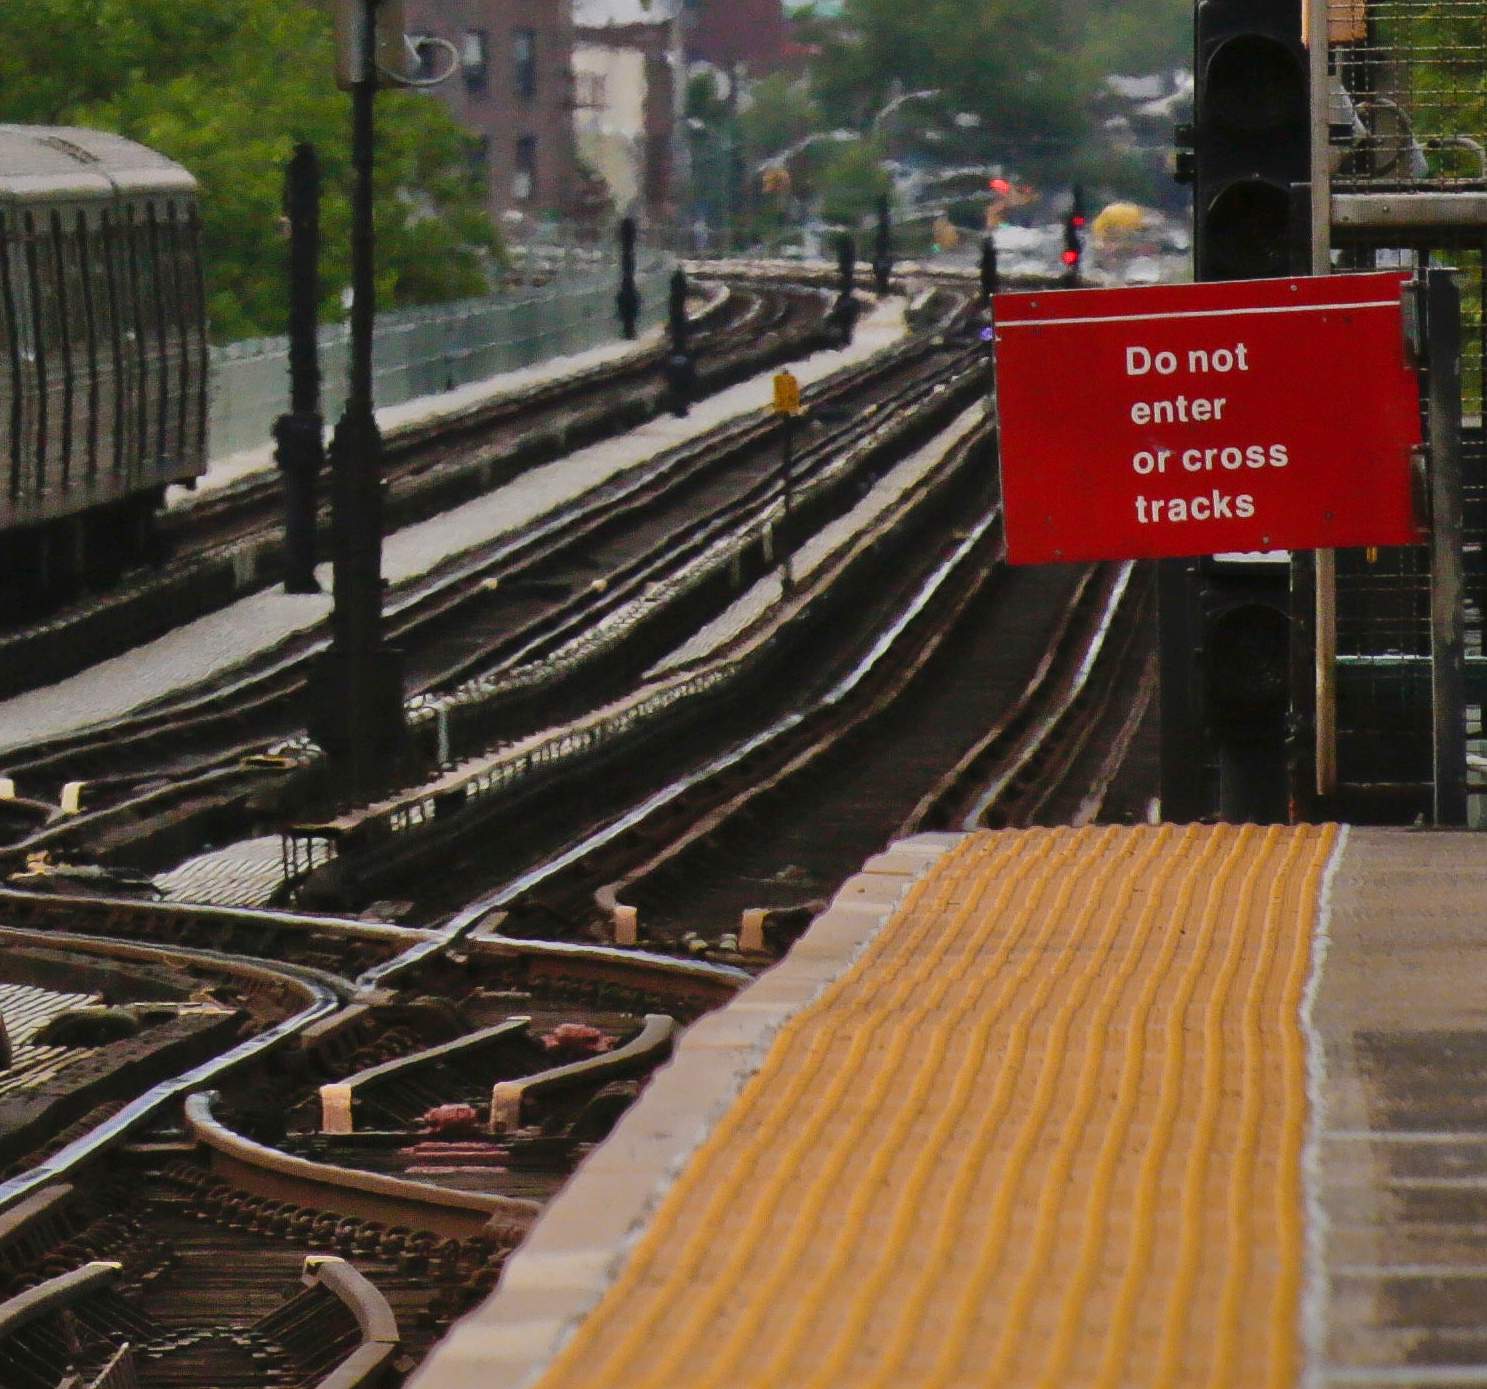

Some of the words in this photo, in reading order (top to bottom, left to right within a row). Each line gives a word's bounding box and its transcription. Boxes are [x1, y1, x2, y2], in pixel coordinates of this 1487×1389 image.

[1126, 346, 1177, 376] Do
[1188, 342, 1249, 373] not
[1130, 395, 1227, 425] enter
[1133, 449, 1171, 474] or
[1182, 442, 1289, 472] cross
[1135, 490, 1255, 524] tracks
